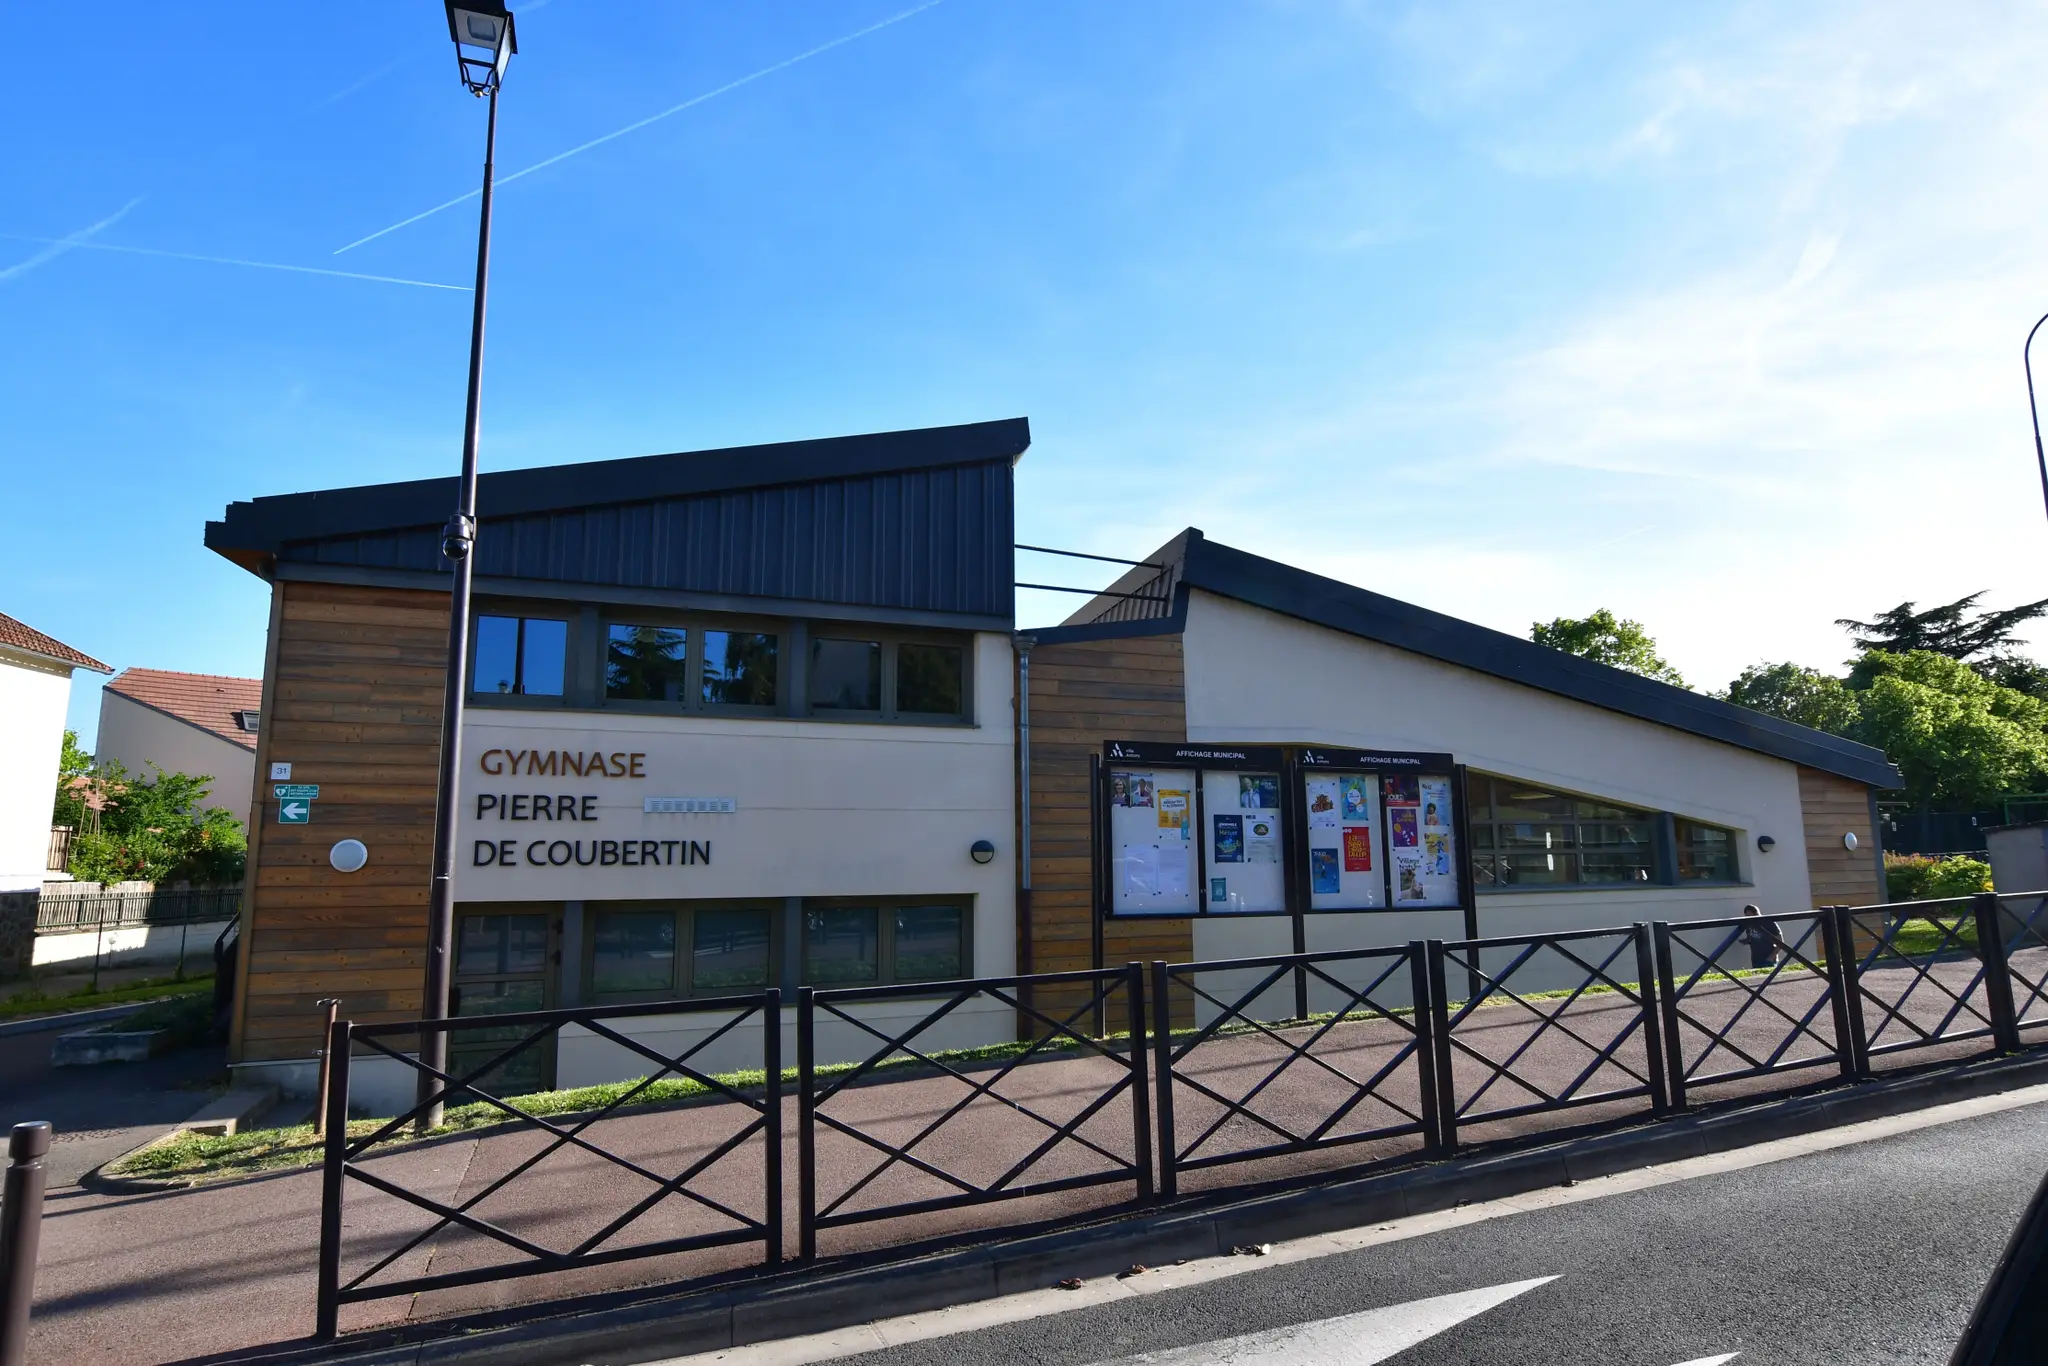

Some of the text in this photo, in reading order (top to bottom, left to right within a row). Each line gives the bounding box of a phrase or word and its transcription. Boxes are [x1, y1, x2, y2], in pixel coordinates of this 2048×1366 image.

[480, 749, 647, 778] GYMNASE
[1176, 750, 1247, 760] AFFICHAGE MUNICIPAL
[1360, 756, 1391, 764] AFFICHAGE
[276, 767, 287, 775] 31
[476, 794, 598, 821] PIERRE
[473, 840, 710, 866] DE COUBERTIN
